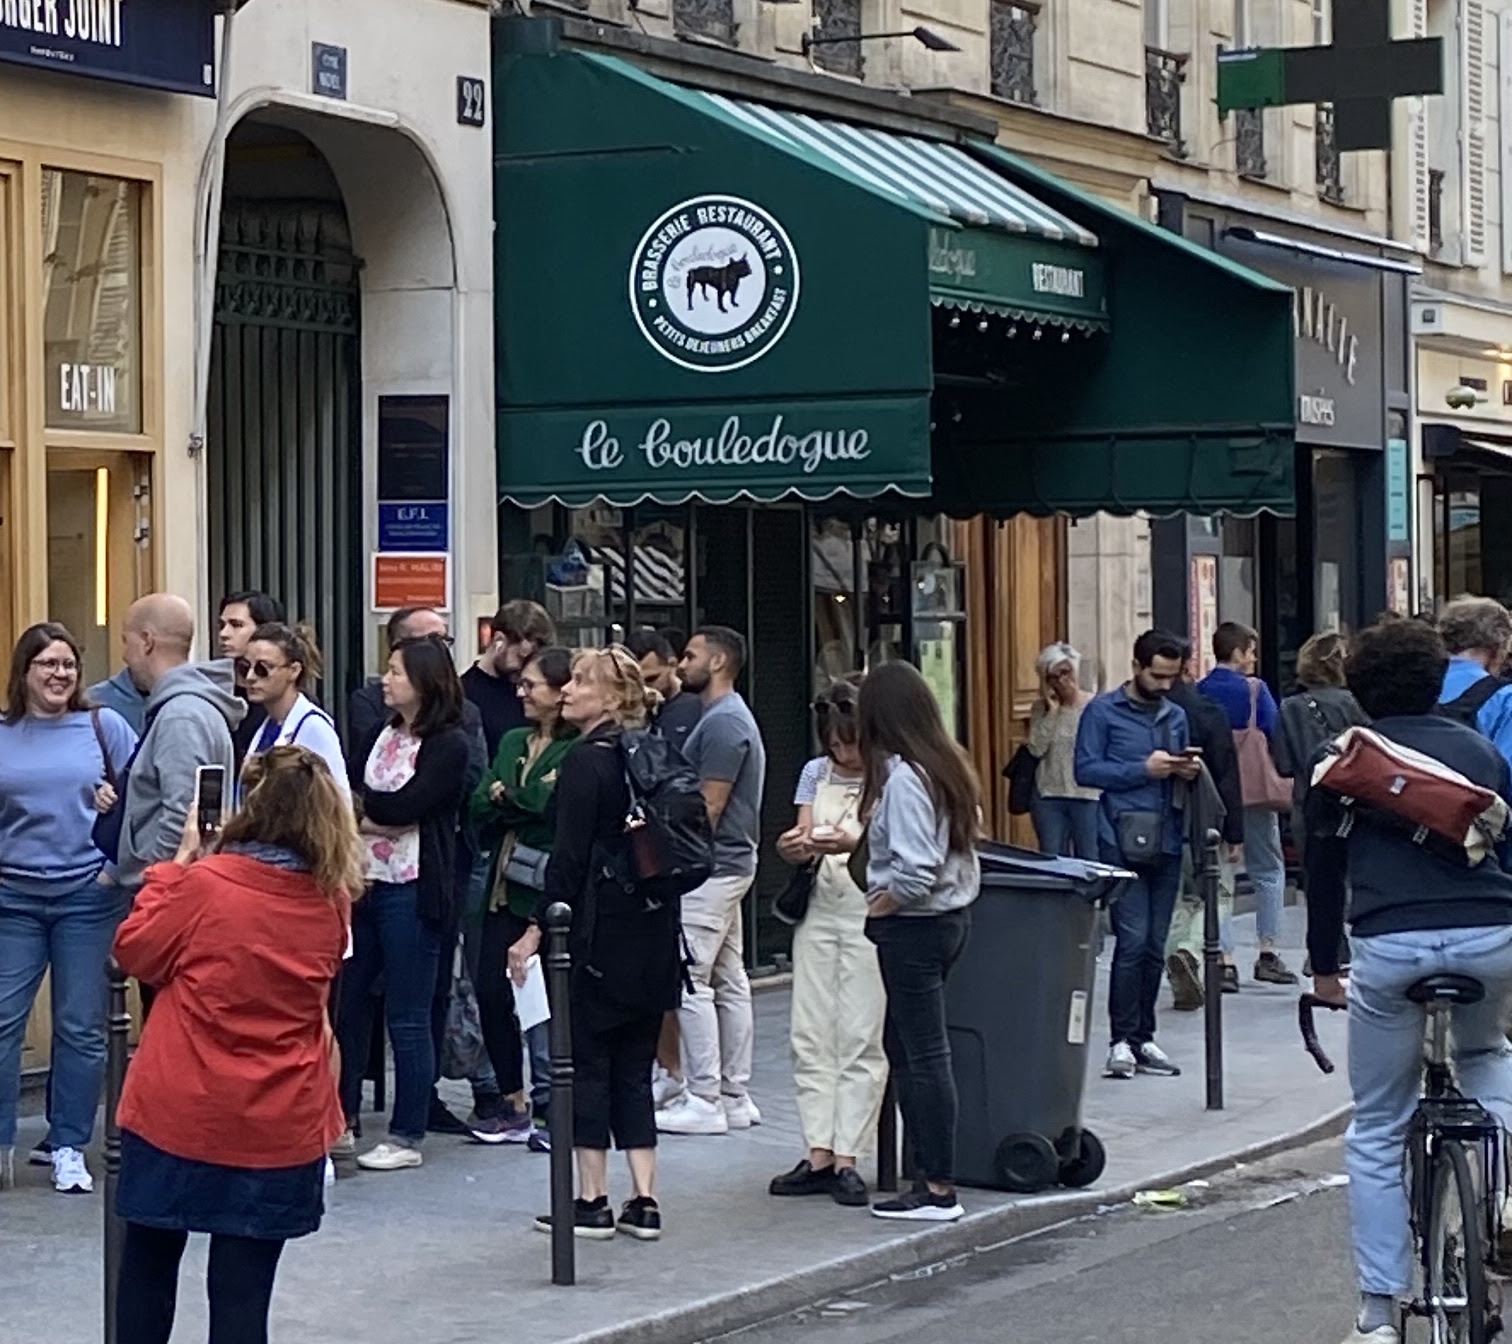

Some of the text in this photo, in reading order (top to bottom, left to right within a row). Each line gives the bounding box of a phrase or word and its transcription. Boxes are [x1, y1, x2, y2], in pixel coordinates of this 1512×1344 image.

[463, 80, 483, 121] 22
[642, 206, 782, 291] BRASSERIE RESTAURANT
[60, 363, 116, 413] EAT-IN
[574, 414, 872, 474] le bouledogue
